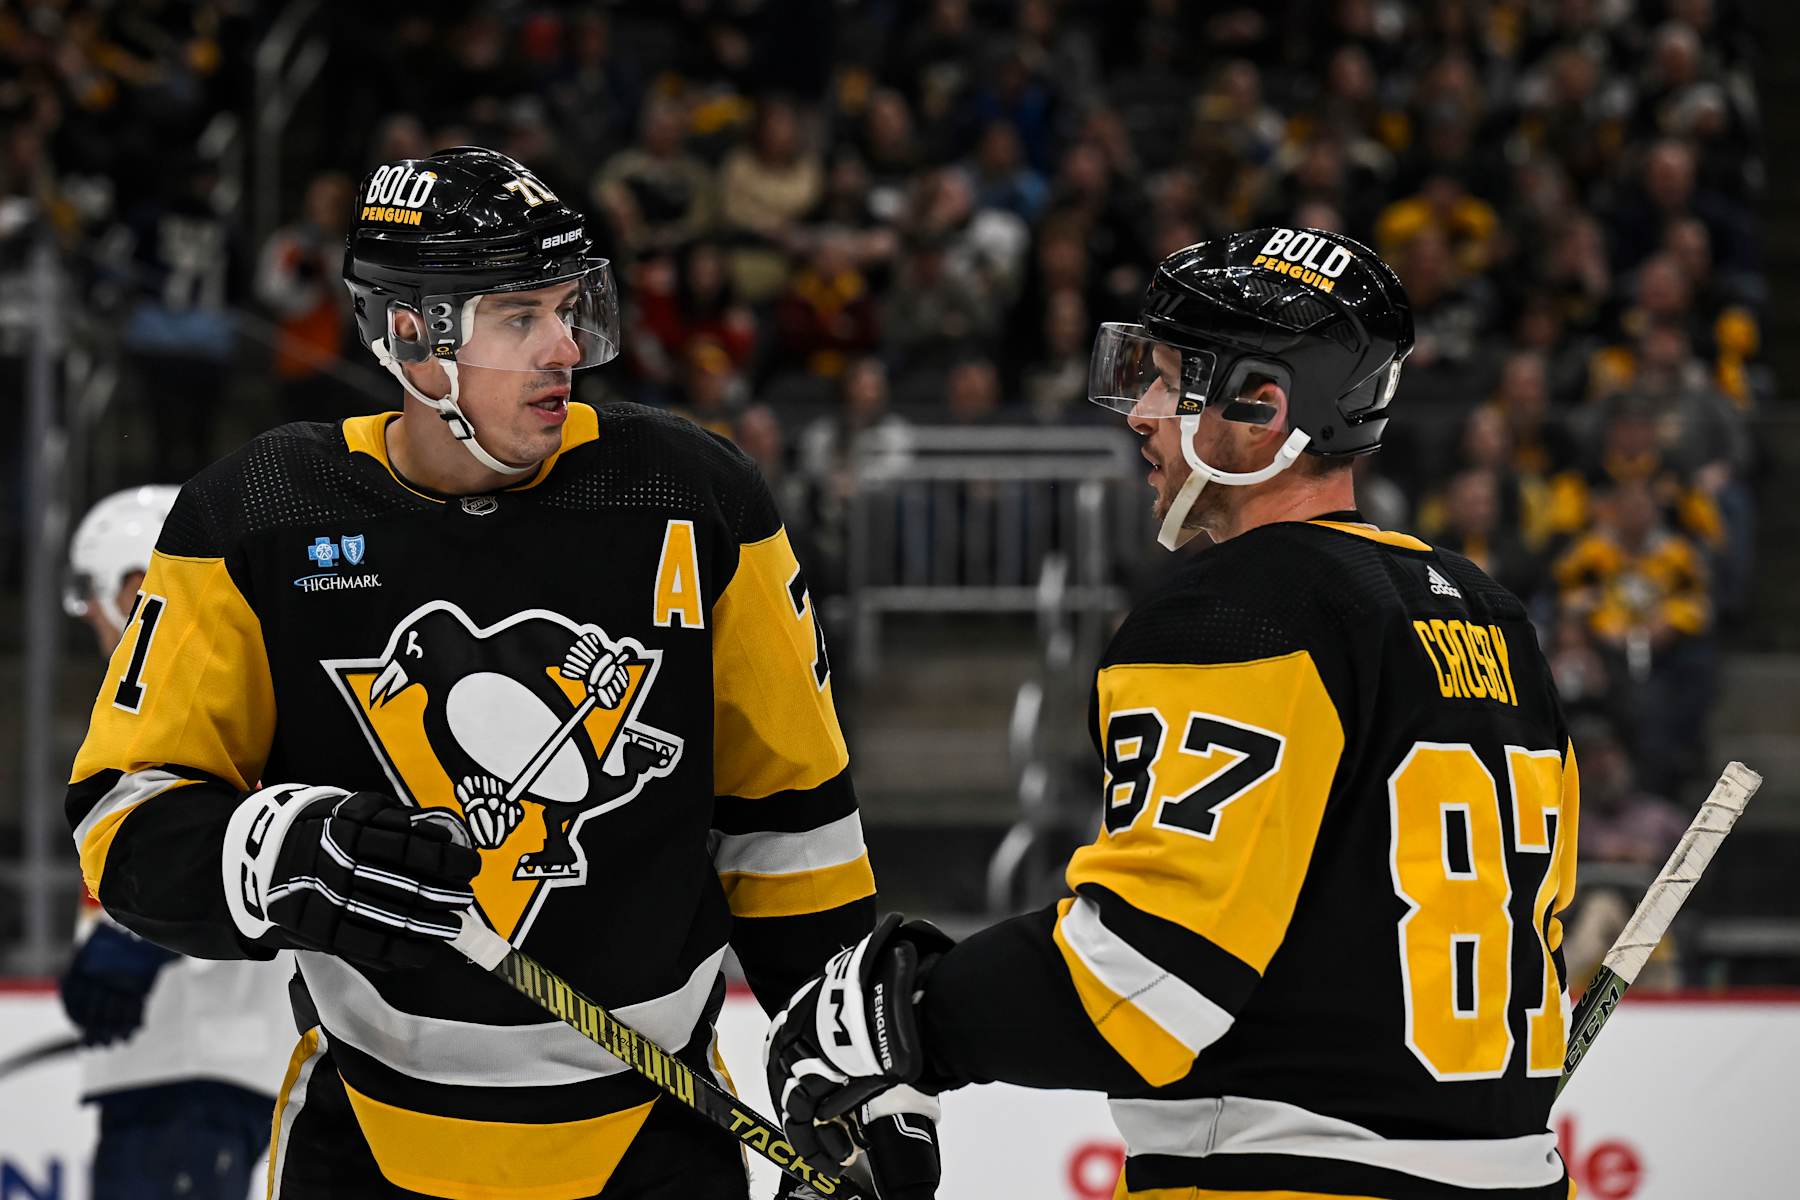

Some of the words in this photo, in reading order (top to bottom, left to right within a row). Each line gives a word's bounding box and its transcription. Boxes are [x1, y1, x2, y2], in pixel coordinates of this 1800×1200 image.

[361, 206, 422, 226] PENGUIN
[366, 165, 436, 208] BOLD
[502, 175, 558, 207] 71
[541, 228, 583, 250] BAUER
[1260, 228, 1351, 278] BOLD
[1252, 254, 1335, 294] PENGUIN
[303, 574, 382, 593] HIGHMARK
[653, 519, 705, 629] A
[1412, 619, 1518, 707] CROSBY
[1103, 707, 1287, 841] 87
[1388, 741, 1565, 1082] 87
[873, 983, 893, 1071] PENGUINS
[1563, 983, 1621, 1075] CCM
[729, 1107, 841, 1195] TACKS
